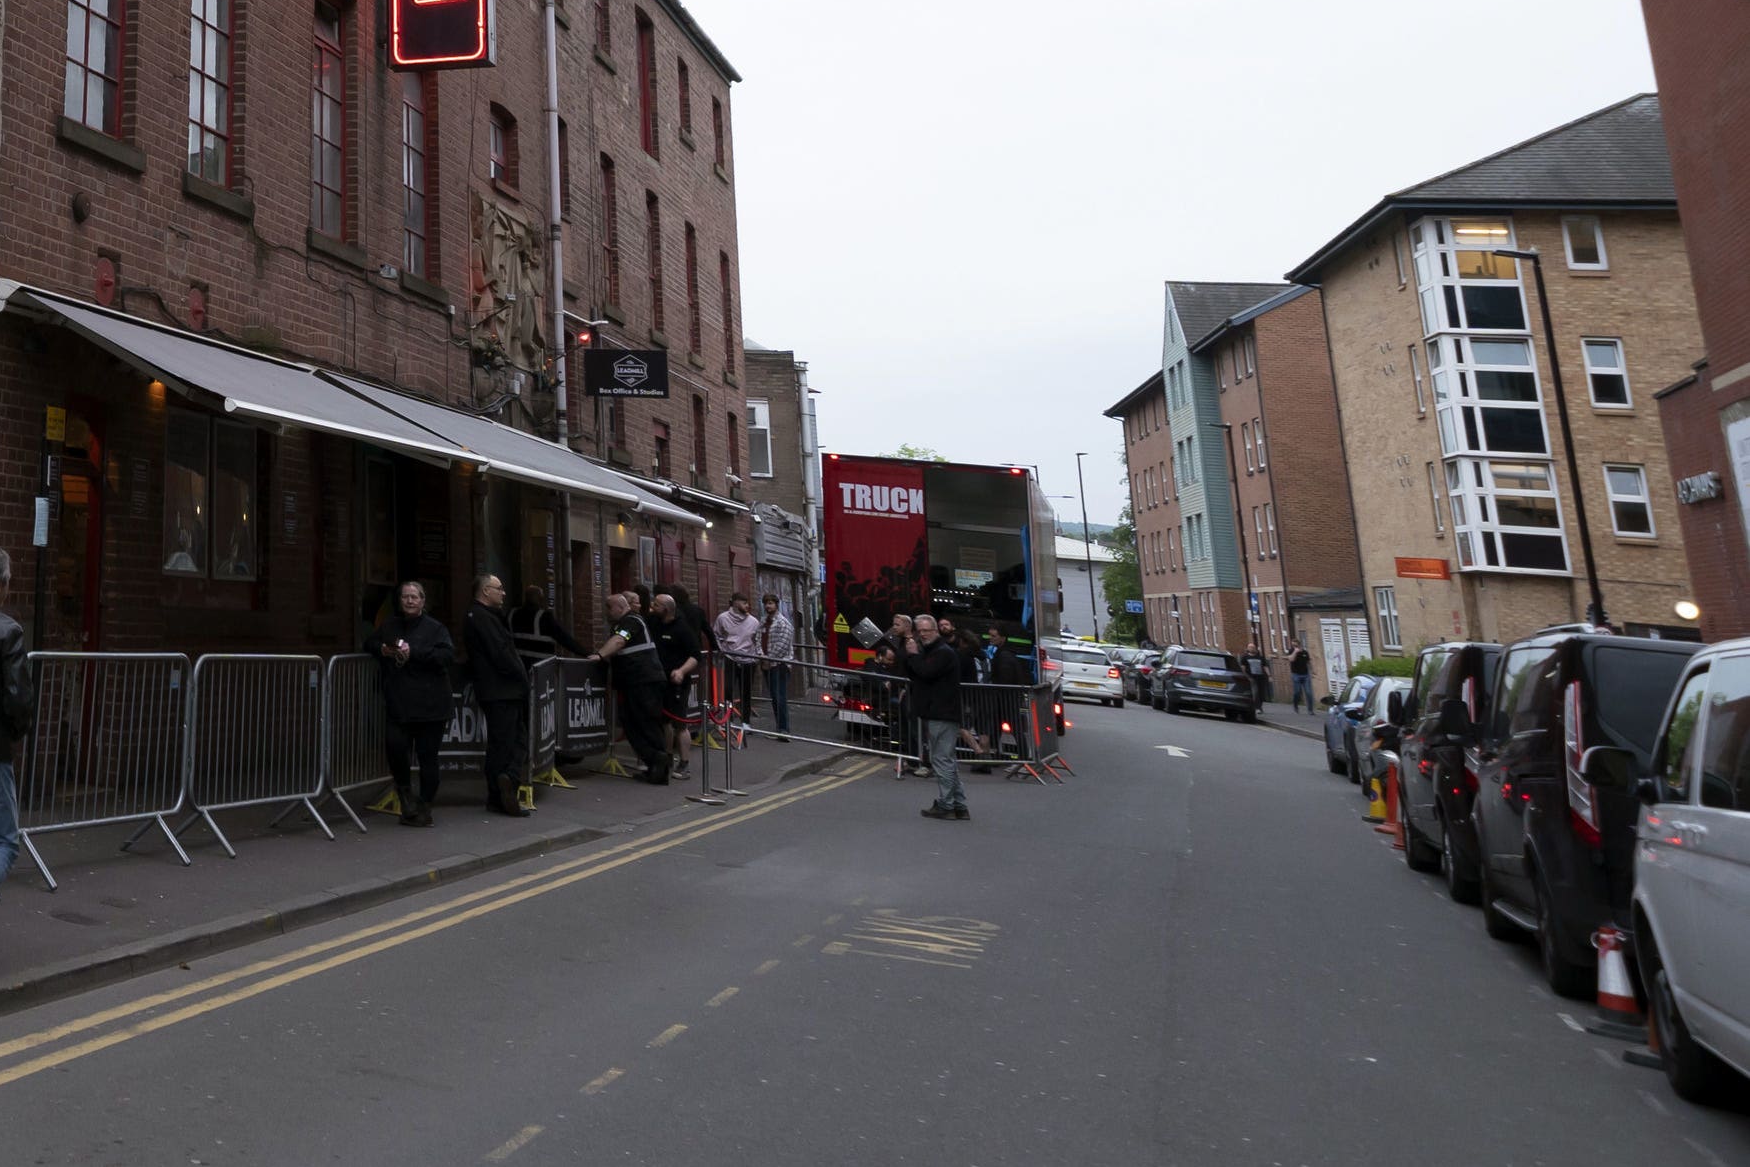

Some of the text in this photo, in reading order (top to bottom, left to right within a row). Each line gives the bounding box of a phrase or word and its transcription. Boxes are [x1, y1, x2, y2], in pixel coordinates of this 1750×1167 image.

[612, 387, 632, 395] Office
[640, 388, 664, 396] Studios
[839, 482, 924, 514] TRUCK
[568, 697, 606, 728] LEADMILL
